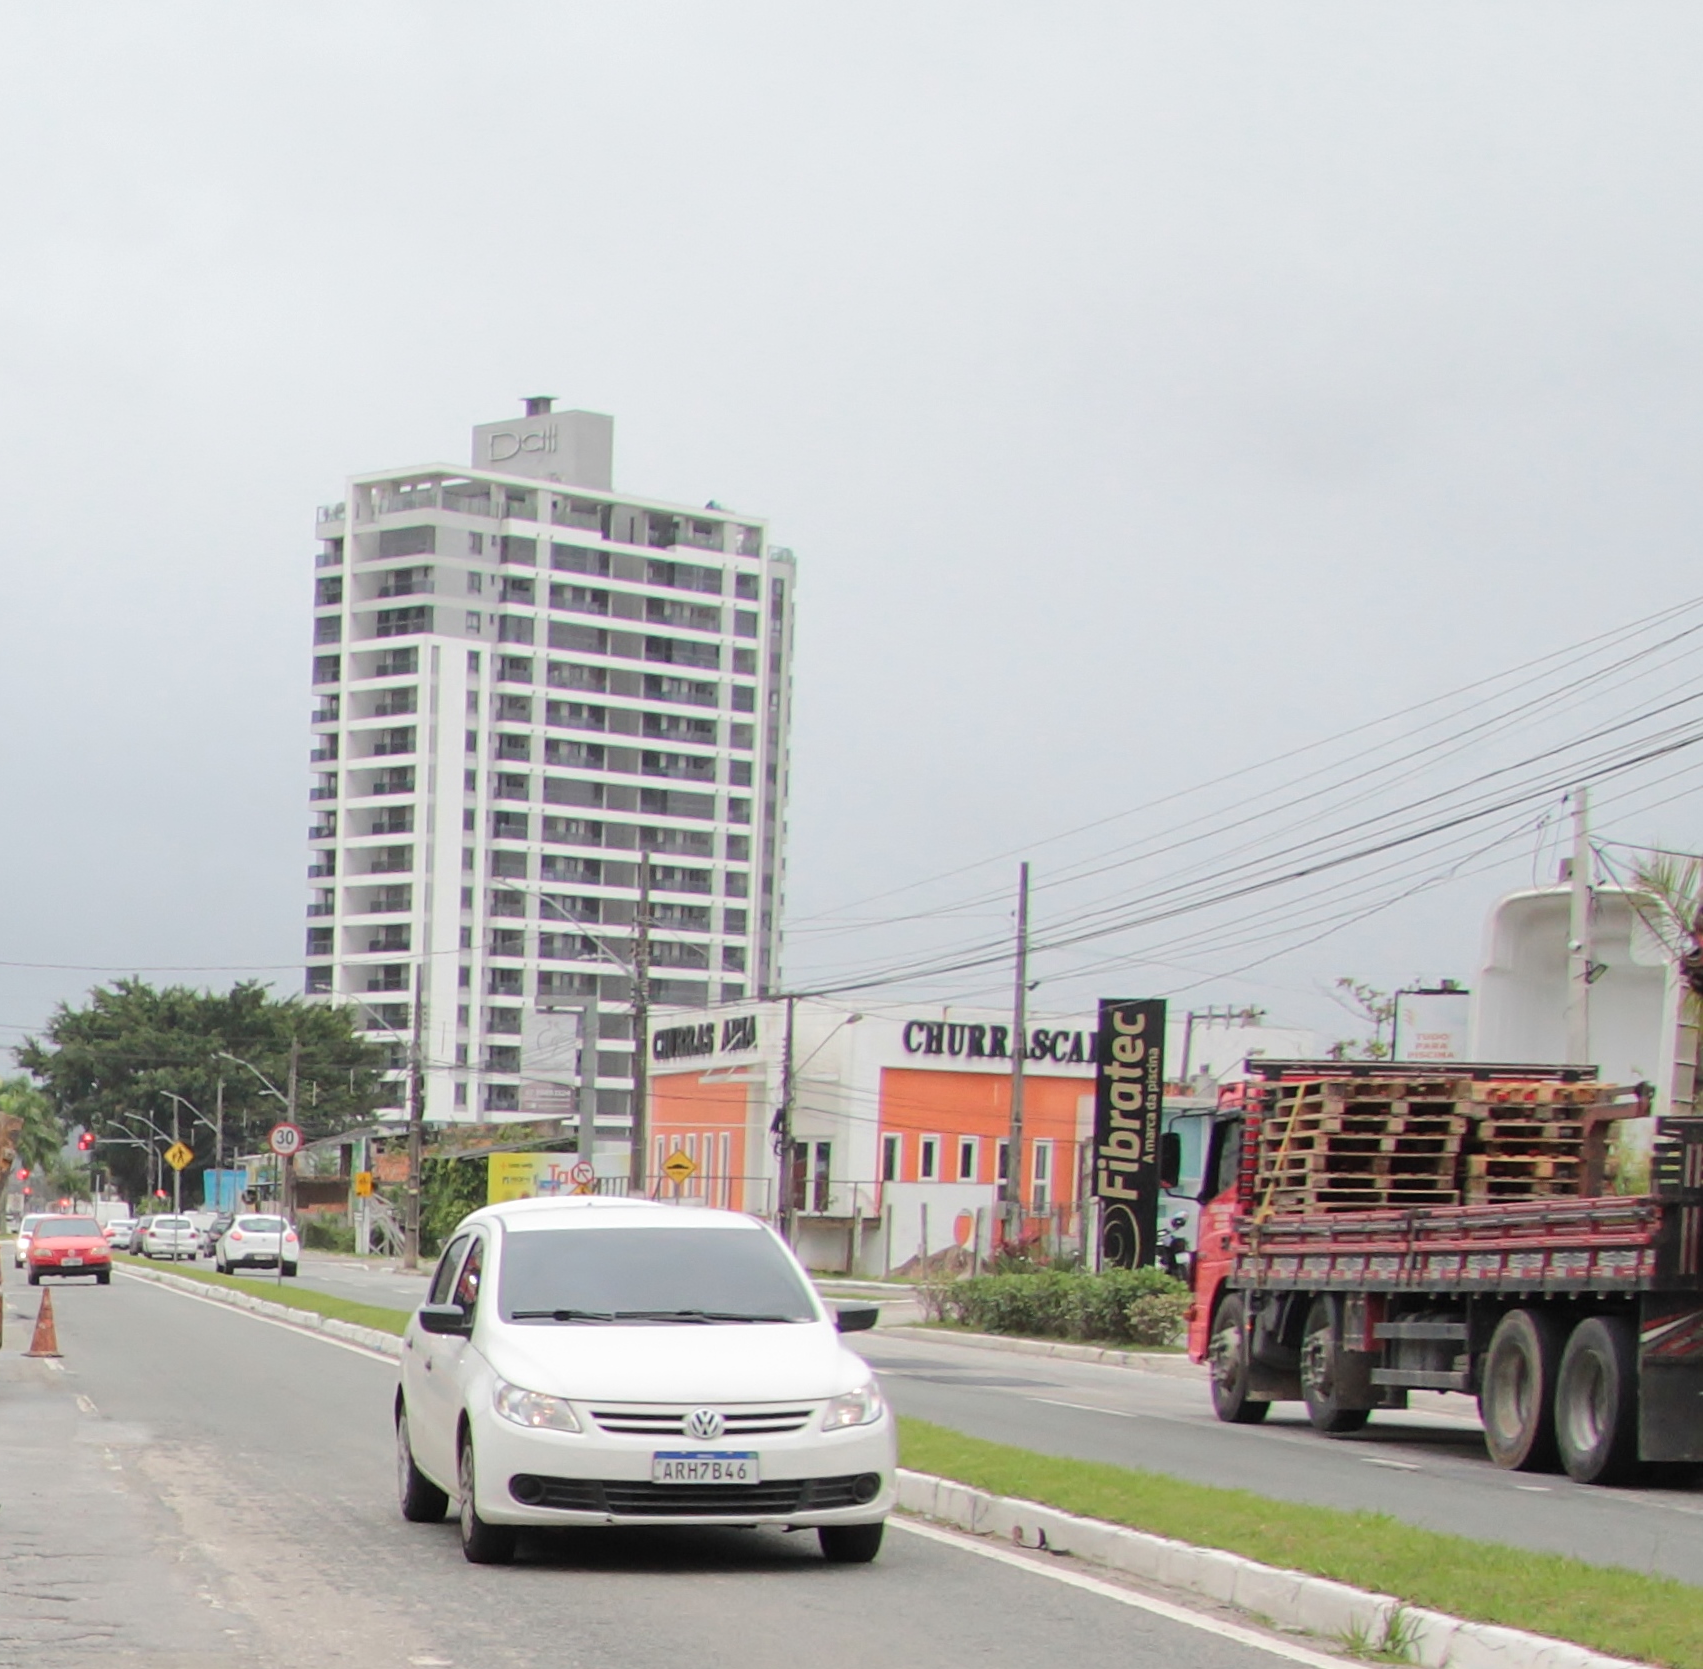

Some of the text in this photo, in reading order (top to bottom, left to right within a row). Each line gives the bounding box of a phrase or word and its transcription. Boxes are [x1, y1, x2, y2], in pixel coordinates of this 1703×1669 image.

[275, 1129, 295, 1145] 30
[1097, 1010, 1146, 1201] Fibratec
[1142, 1047, 1161, 1164] A marca da piscina
[662, 1462, 747, 1481] ARH7B46
